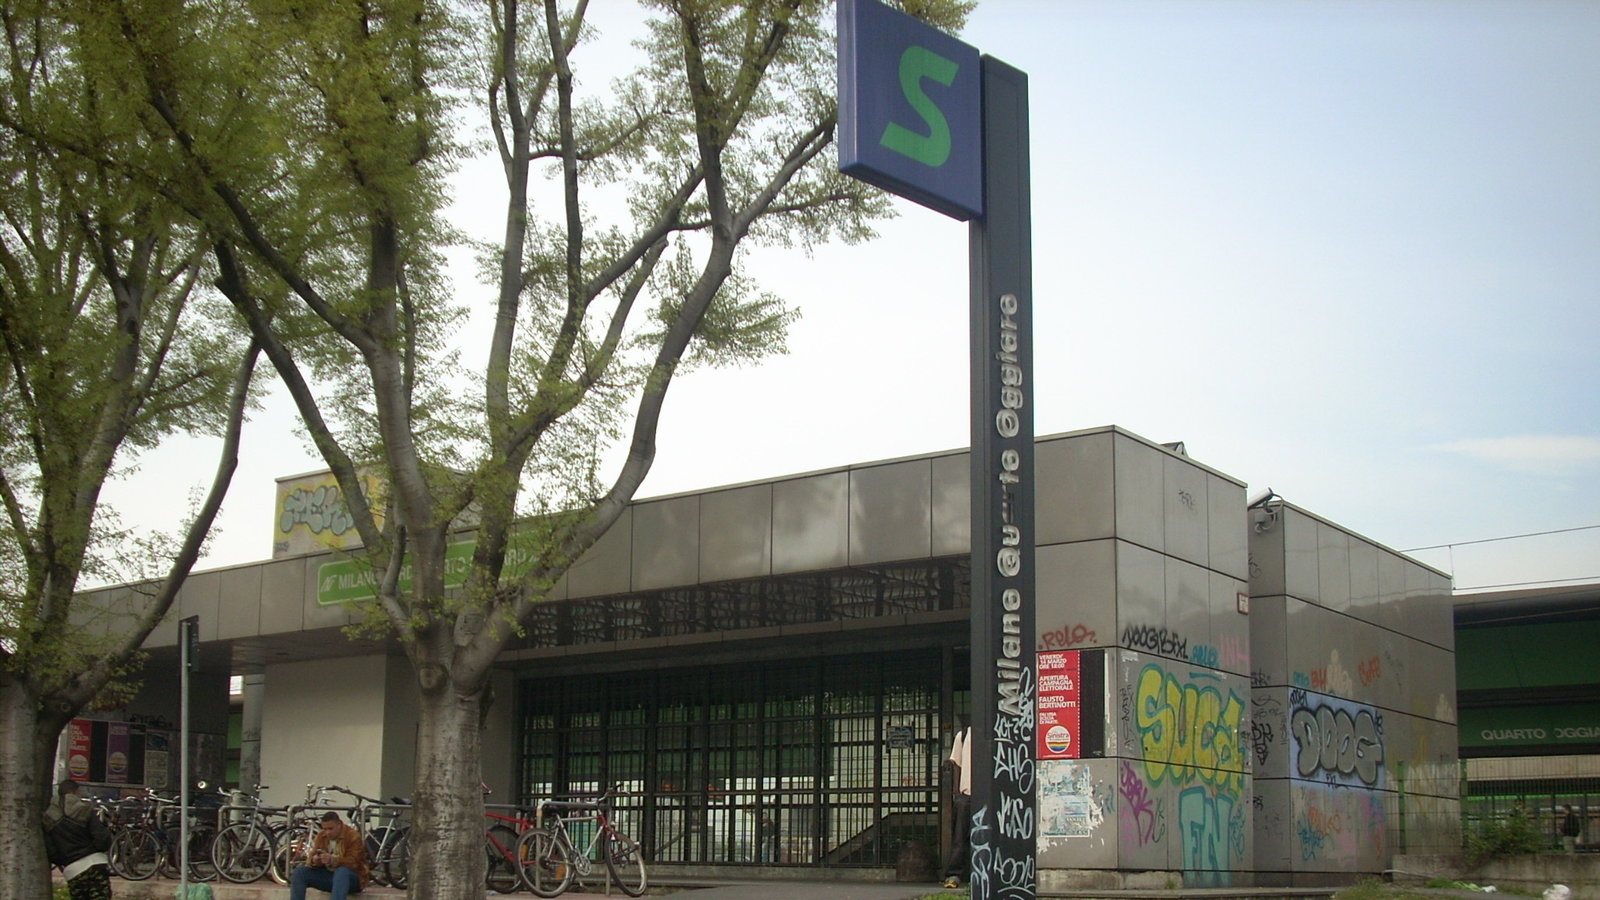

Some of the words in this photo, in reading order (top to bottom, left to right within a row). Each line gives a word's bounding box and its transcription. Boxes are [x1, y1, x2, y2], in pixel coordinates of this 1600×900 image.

[879, 45, 960, 168] S
[995, 293, 1024, 438] Oggiaro
[996, 449, 1021, 578] Quto
[996, 588, 1021, 716] Milano
[1039, 701, 1076, 709] BERTINOTTI
[1480, 728, 1547, 740] QUARTO
